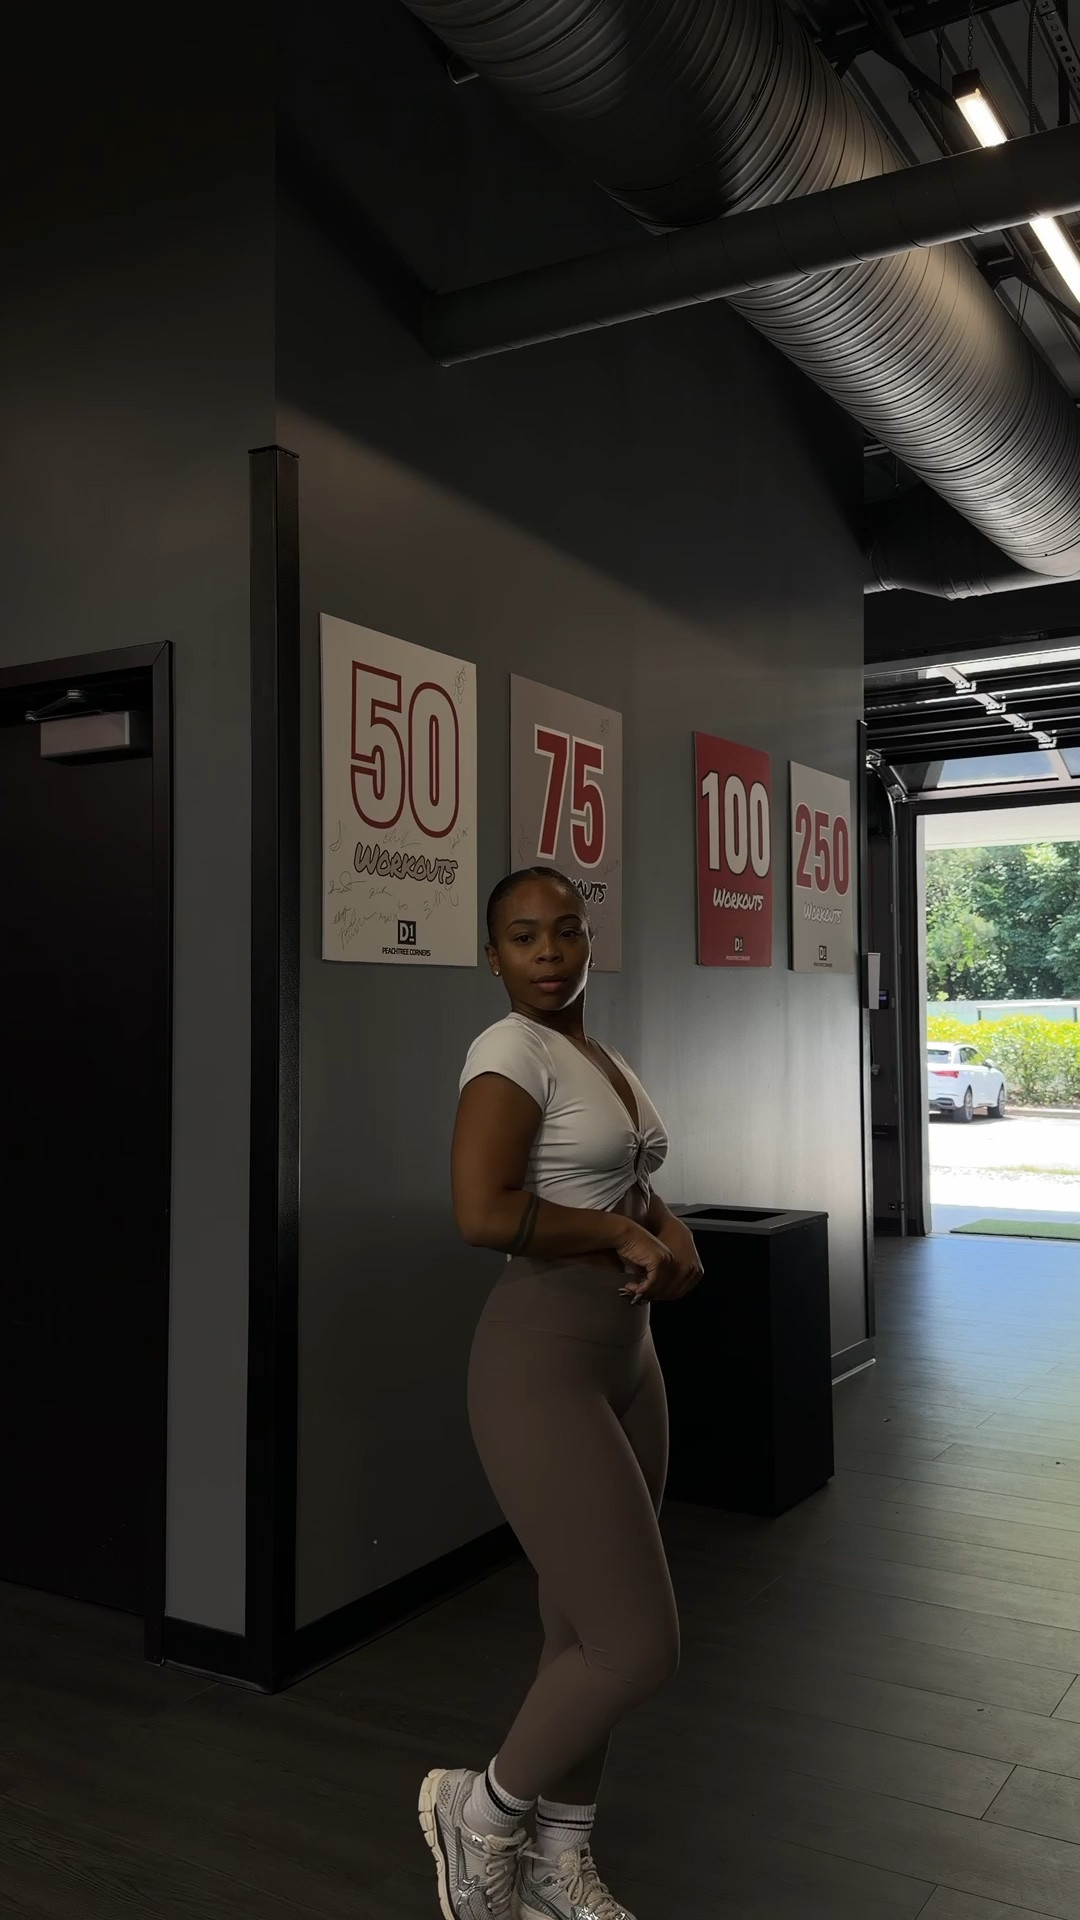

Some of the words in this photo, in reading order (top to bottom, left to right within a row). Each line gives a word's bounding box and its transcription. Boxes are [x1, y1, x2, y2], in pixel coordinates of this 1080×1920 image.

[350, 660, 459, 839] 50
[534, 723, 607, 869] 75
[353, 841, 459, 885] WORKOUTS
[701, 769, 771, 878] 100
[795, 802, 849, 896] 250
[712, 887, 764, 912] WORKOUTS
[803, 902, 843, 925] WORKOUTS
